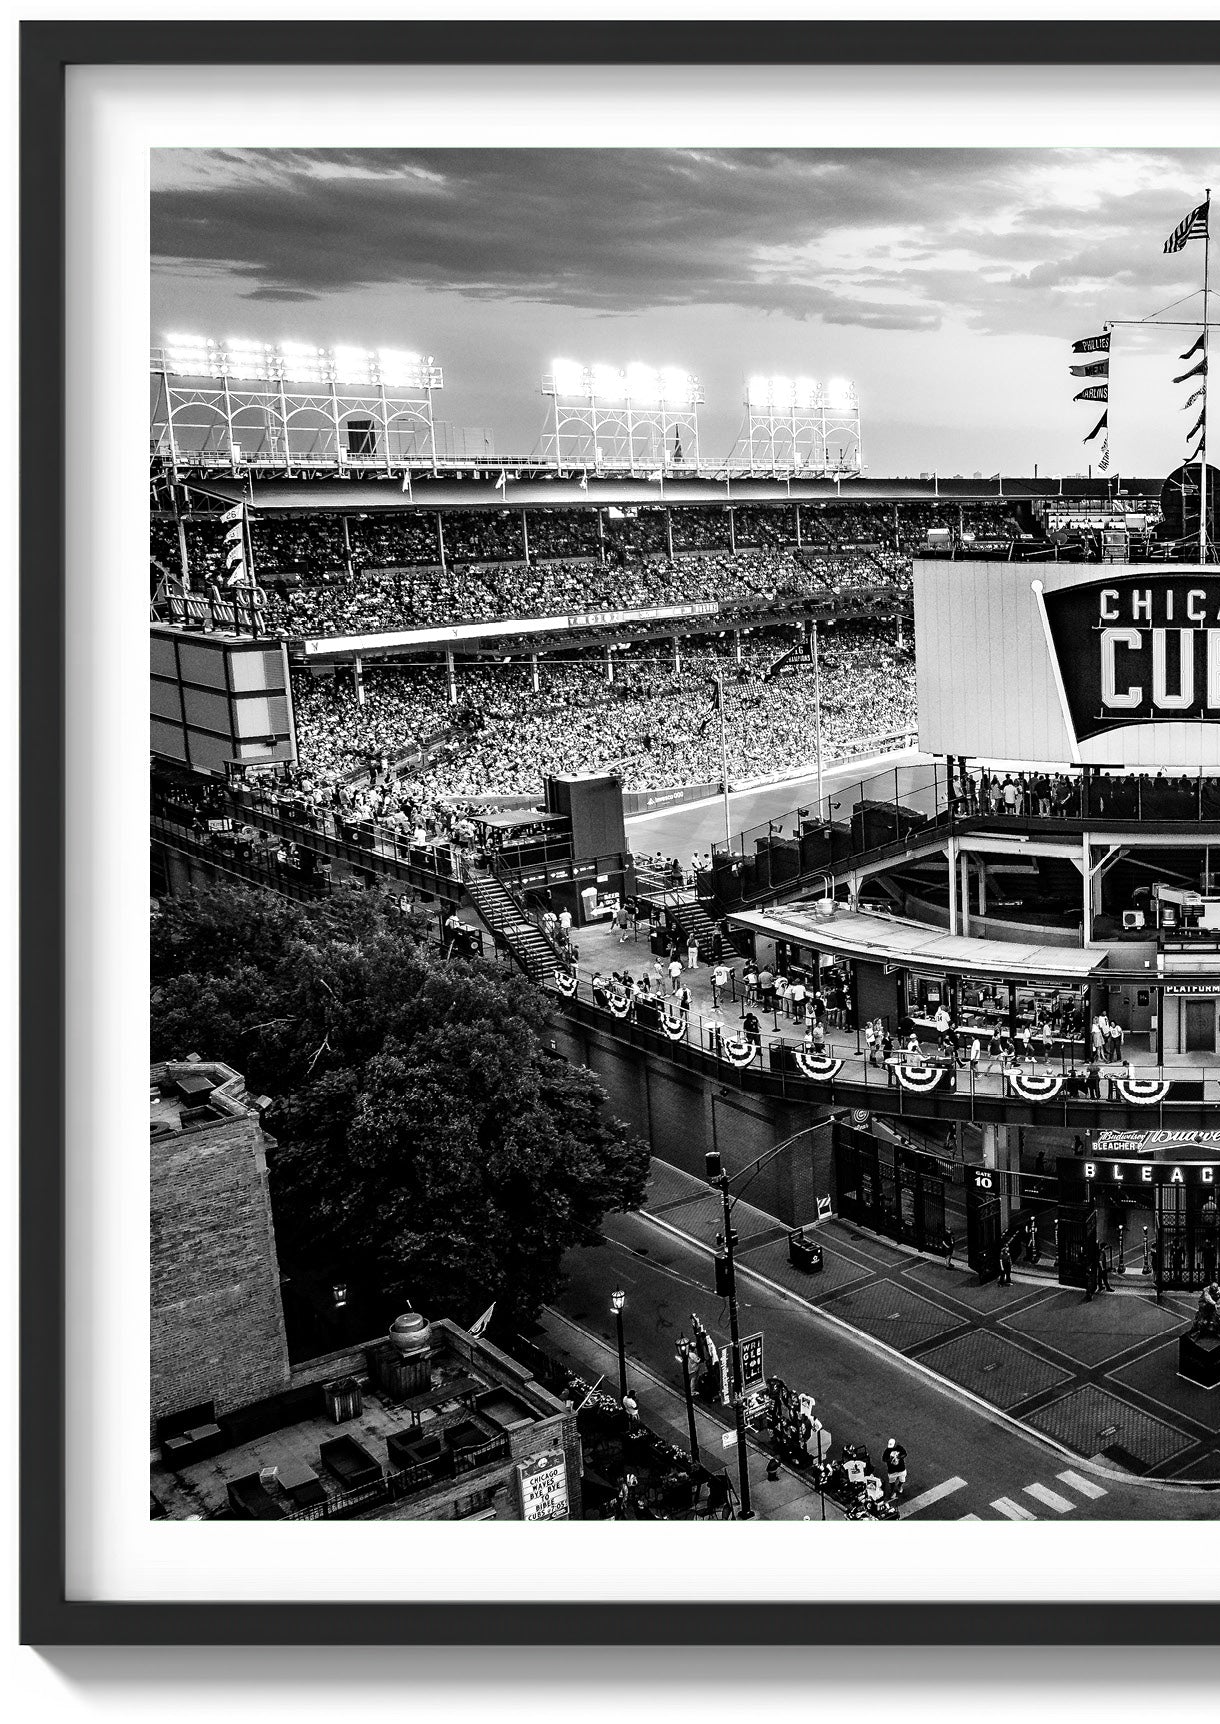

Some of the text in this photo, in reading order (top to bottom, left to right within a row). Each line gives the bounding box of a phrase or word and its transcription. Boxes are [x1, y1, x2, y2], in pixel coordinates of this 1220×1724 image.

[1082, 337, 1110, 351] PHILLIES
[1166, 985, 1220, 993] PLATFORM
[1092, 1141, 1134, 1151] BLEACHER
[975, 1170, 992, 1179] GATE
[974, 1176, 993, 1189] 10
[529, 1469, 558, 1486] CHICAGO
[532, 1477, 555, 1491] WAVES
[530, 1482, 561, 1500] BYE BYE
[541, 1494, 550, 1502] TO
[528, 1509, 546, 1521] CUBS
